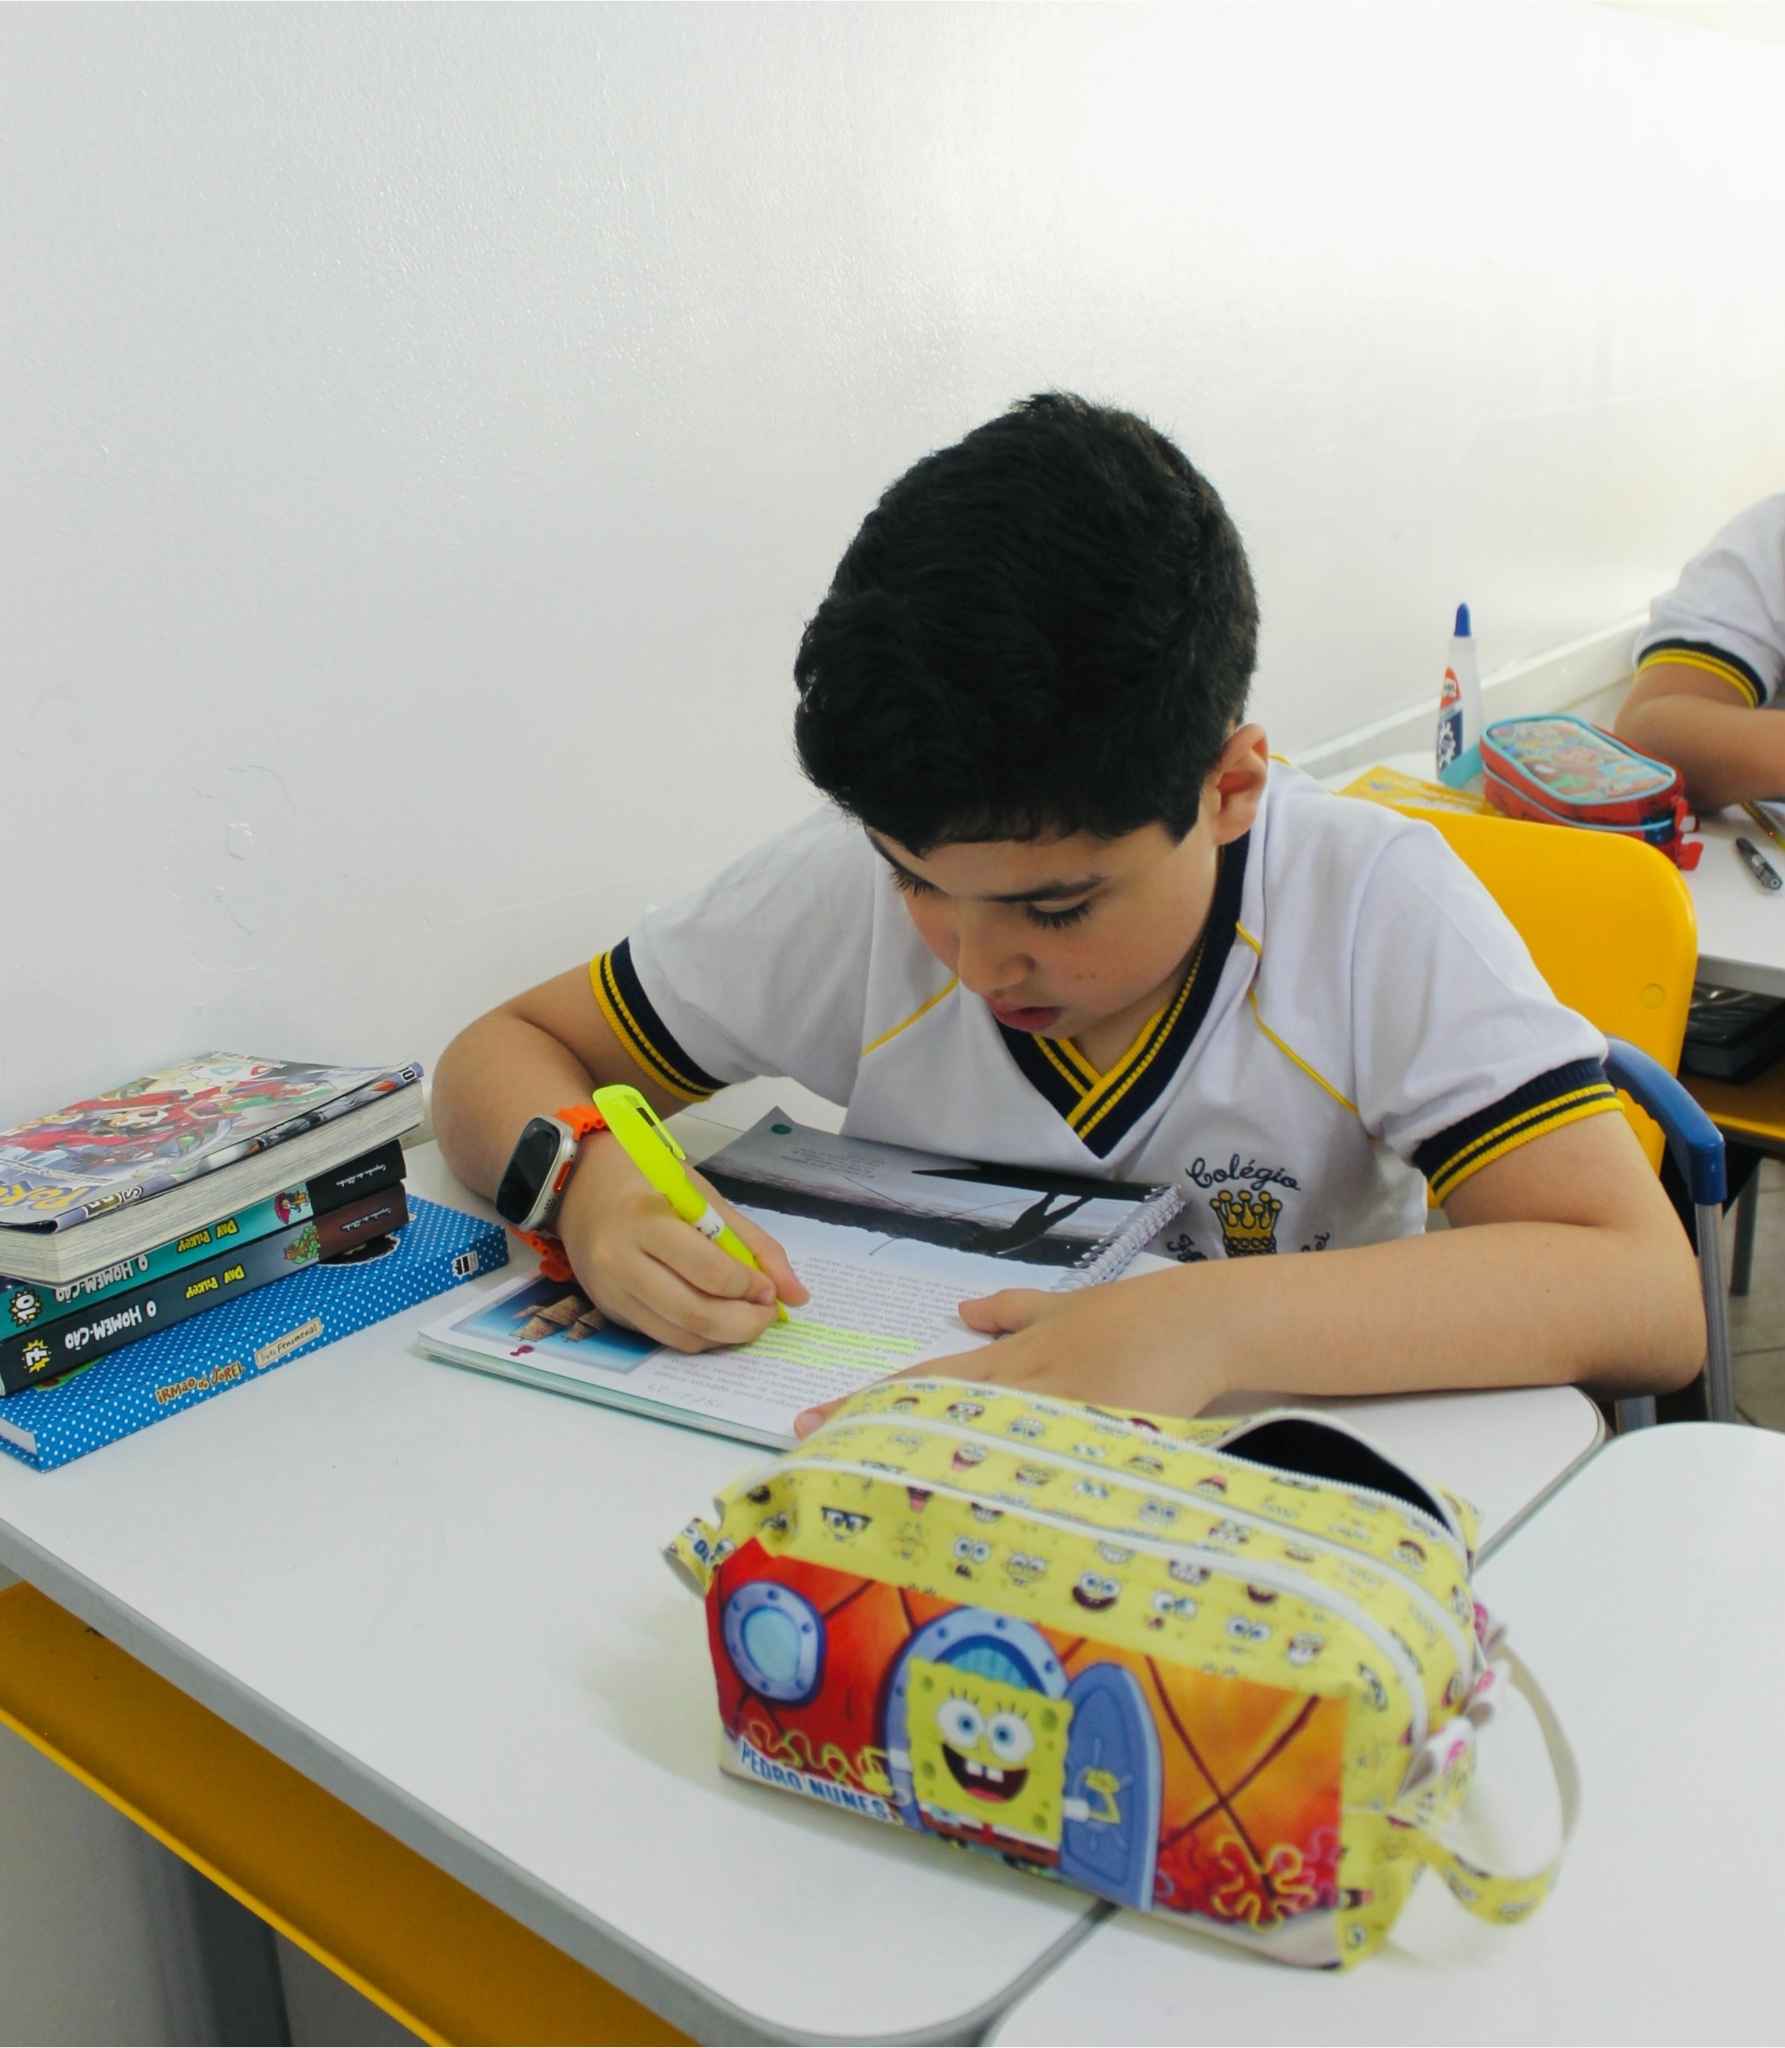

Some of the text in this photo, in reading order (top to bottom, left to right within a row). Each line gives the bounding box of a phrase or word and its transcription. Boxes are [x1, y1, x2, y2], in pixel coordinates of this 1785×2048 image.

[1185, 1153, 1301, 1191] Colégio
[16, 1293, 37, 1321] 10
[65, 1300, 157, 1350] O HOMEM-CÃO
[740, 1737, 888, 1819] PEDRO NUNES
